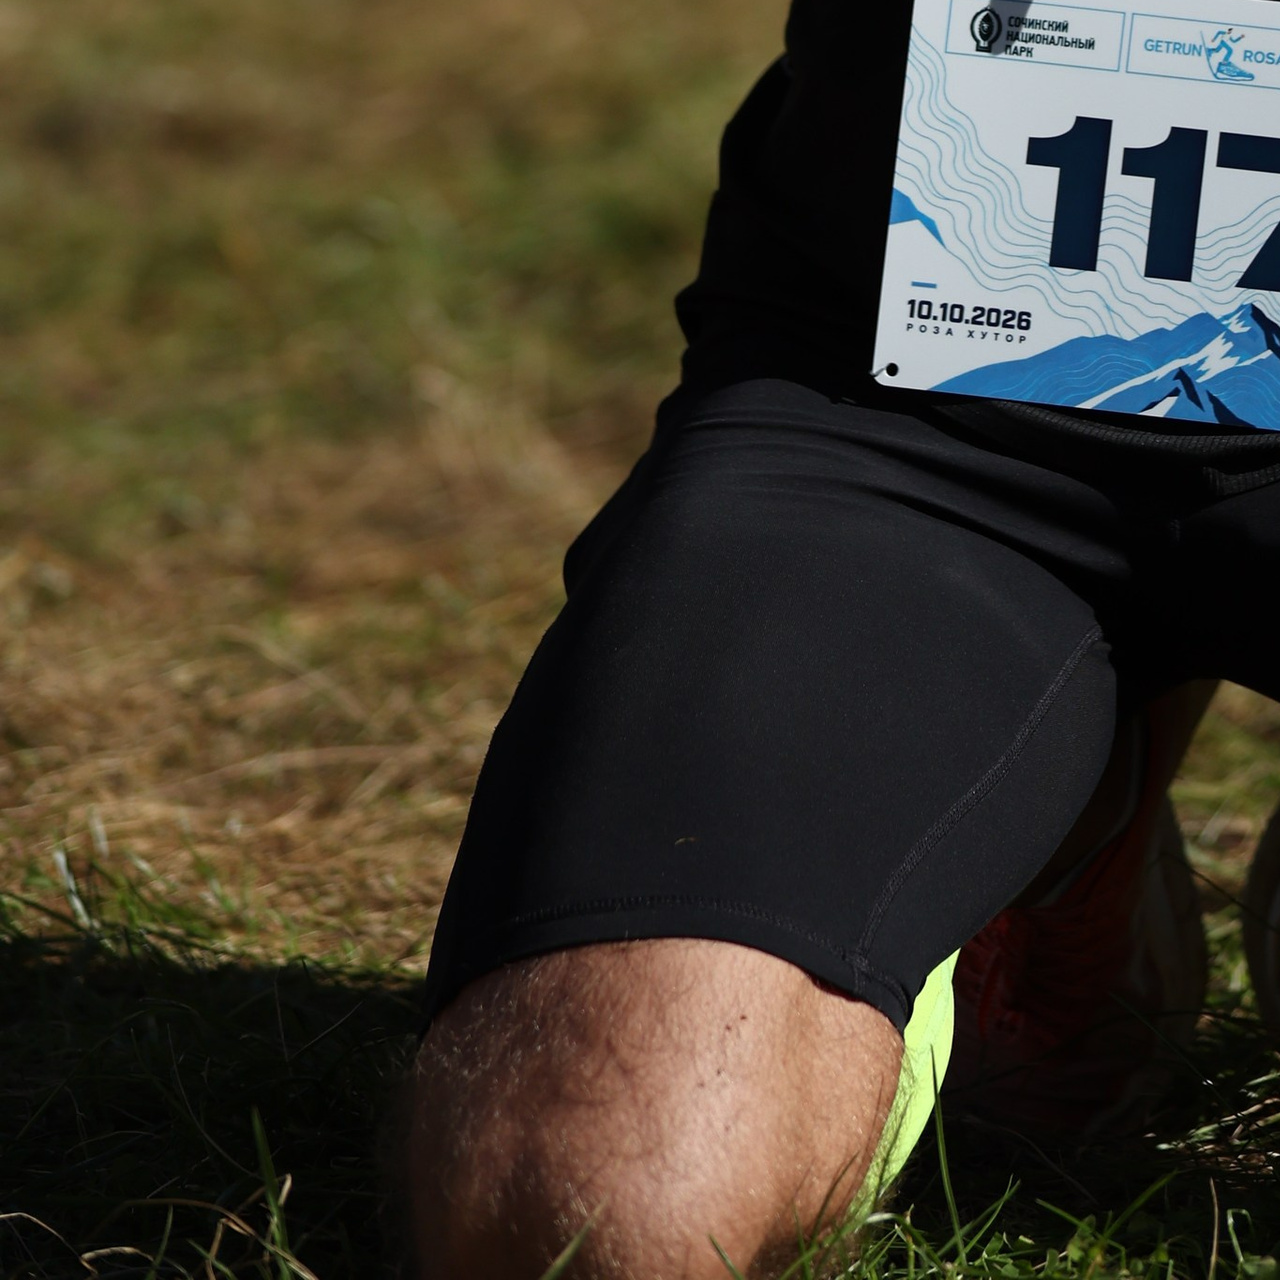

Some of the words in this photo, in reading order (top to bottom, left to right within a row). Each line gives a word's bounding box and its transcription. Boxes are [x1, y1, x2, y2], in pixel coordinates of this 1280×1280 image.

[1007, 16, 1069, 33] СОЧИНСКИЙ
[1006, 30, 1096, 51] НАЦИОНАЛЬНЫЙ
[1143, 38, 1203, 57] GETRUN
[1004, 44, 1035, 58] ПАРК
[907, 298, 1032, 331] 10.10.2026
[906, 323, 953, 336] РОЗА
[966, 329, 1026, 344] ХУТОР
